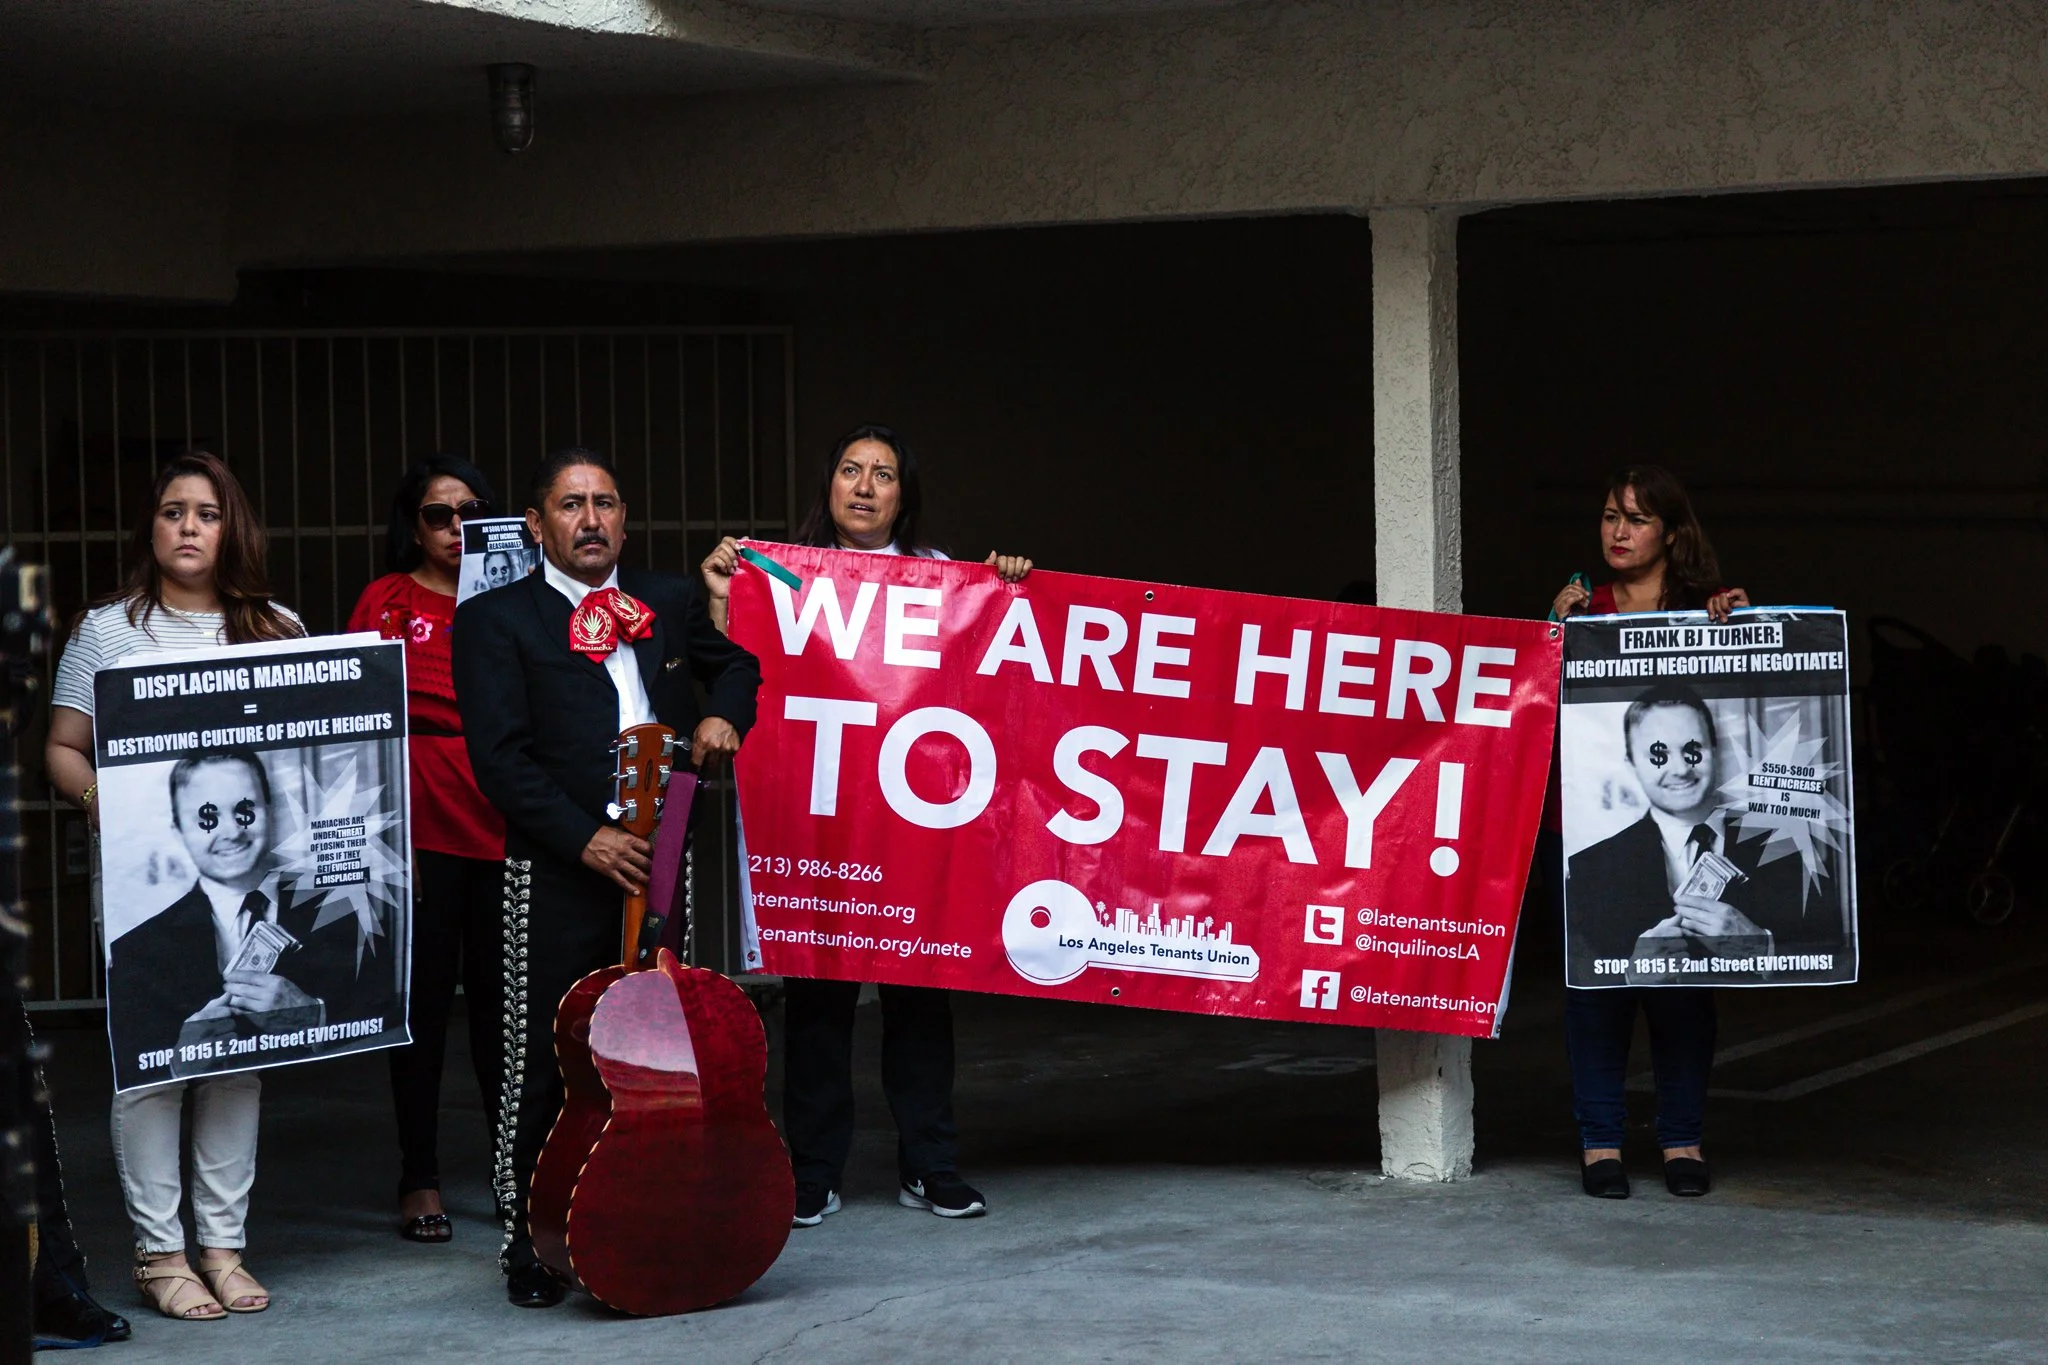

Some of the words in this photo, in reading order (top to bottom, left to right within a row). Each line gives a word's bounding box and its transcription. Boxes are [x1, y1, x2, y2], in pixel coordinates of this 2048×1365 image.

[767, 572, 942, 669] WE
[976, 597, 1196, 699] ARE
[1233, 623, 1517, 728] HERE
[1624, 630, 1680, 650] FRANK
[1684, 628, 1702, 647] BJ
[1708, 626, 1781, 646] TURNER:
[133, 668, 250, 700] DISPLACING
[253, 658, 362, 689] MARIACHIS
[1566, 657, 1654, 679] NEGOTIATE!
[1657, 655, 1747, 676] NEGOTIATE!
[1750, 652, 1844, 672] NEGOTIATE!
[108, 731, 198, 757] DESTROYING
[201, 726, 264, 747] CULTURE
[266, 725, 284, 740] OF
[286, 718, 330, 739] BOYLE
[332, 713, 392, 735] HEIGHTS
[1649, 740, 1668, 768] $
[1683, 738, 1703, 768] $
[1762, 762, 1815, 778] $550-$800
[784, 695, 997, 829] TO
[1045, 725, 1465, 877] STAY!
[1753, 776, 1776, 787] RENT
[1777, 778, 1822, 792] INCREASE
[1780, 792, 1790, 802] IS
[198, 802, 219, 834] $
[234, 797, 256, 830] $
[311, 818, 350, 830] MARIACHIS
[352, 816, 364, 825] ARE
[1748, 802, 1769, 814] WAY
[1770, 804, 1788, 816] TOO
[1790, 807, 1820, 819] MUCH!
[310, 843, 320, 852] OF
[320, 840, 345, 850] LOSING
[347, 838, 367, 848] THEIR
[313, 830, 336, 840] UNDER
[337, 827, 364, 838] THREAT
[317, 853, 334, 862] JOBS
[336, 852, 342, 860] IF
[344, 850, 361, 860] THEY
[317, 864, 331, 873] GET
[331, 860, 360, 872] EVICTED
[748, 854, 791, 878] 213)
[798, 859, 882, 882] 986-8266
[322, 872, 364, 884] DISPLACED!
[752, 892, 916, 924] atenantsunion.org
[1357, 908, 1505, 937] @latenantsunion
[757, 925, 972, 958] tenantsunion.org/unete
[1059, 934, 1084, 948] Los
[1088, 937, 1146, 956] Angeles
[1150, 944, 1204, 961] Tenants
[1208, 950, 1250, 966] Union
[1355, 934, 1481, 961] @inquilinosLA
[1594, 960, 1629, 974] STOP
[1634, 958, 1666, 974] 1815
[1668, 958, 1680, 973] E.
[1682, 958, 1708, 973] 2nd
[1711, 957, 1755, 972] Street
[1756, 955, 1833, 972] EVICTIONS!
[1350, 985, 1497, 1014] @latenantsunion
[138, 1048, 174, 1070] STOP
[179, 1042, 212, 1063] 1815
[215, 1040, 226, 1058] E.
[228, 1036, 257, 1056] 2nd
[259, 1030, 305, 1051] Street
[307, 1018, 384, 1044] EVICTIONS!
